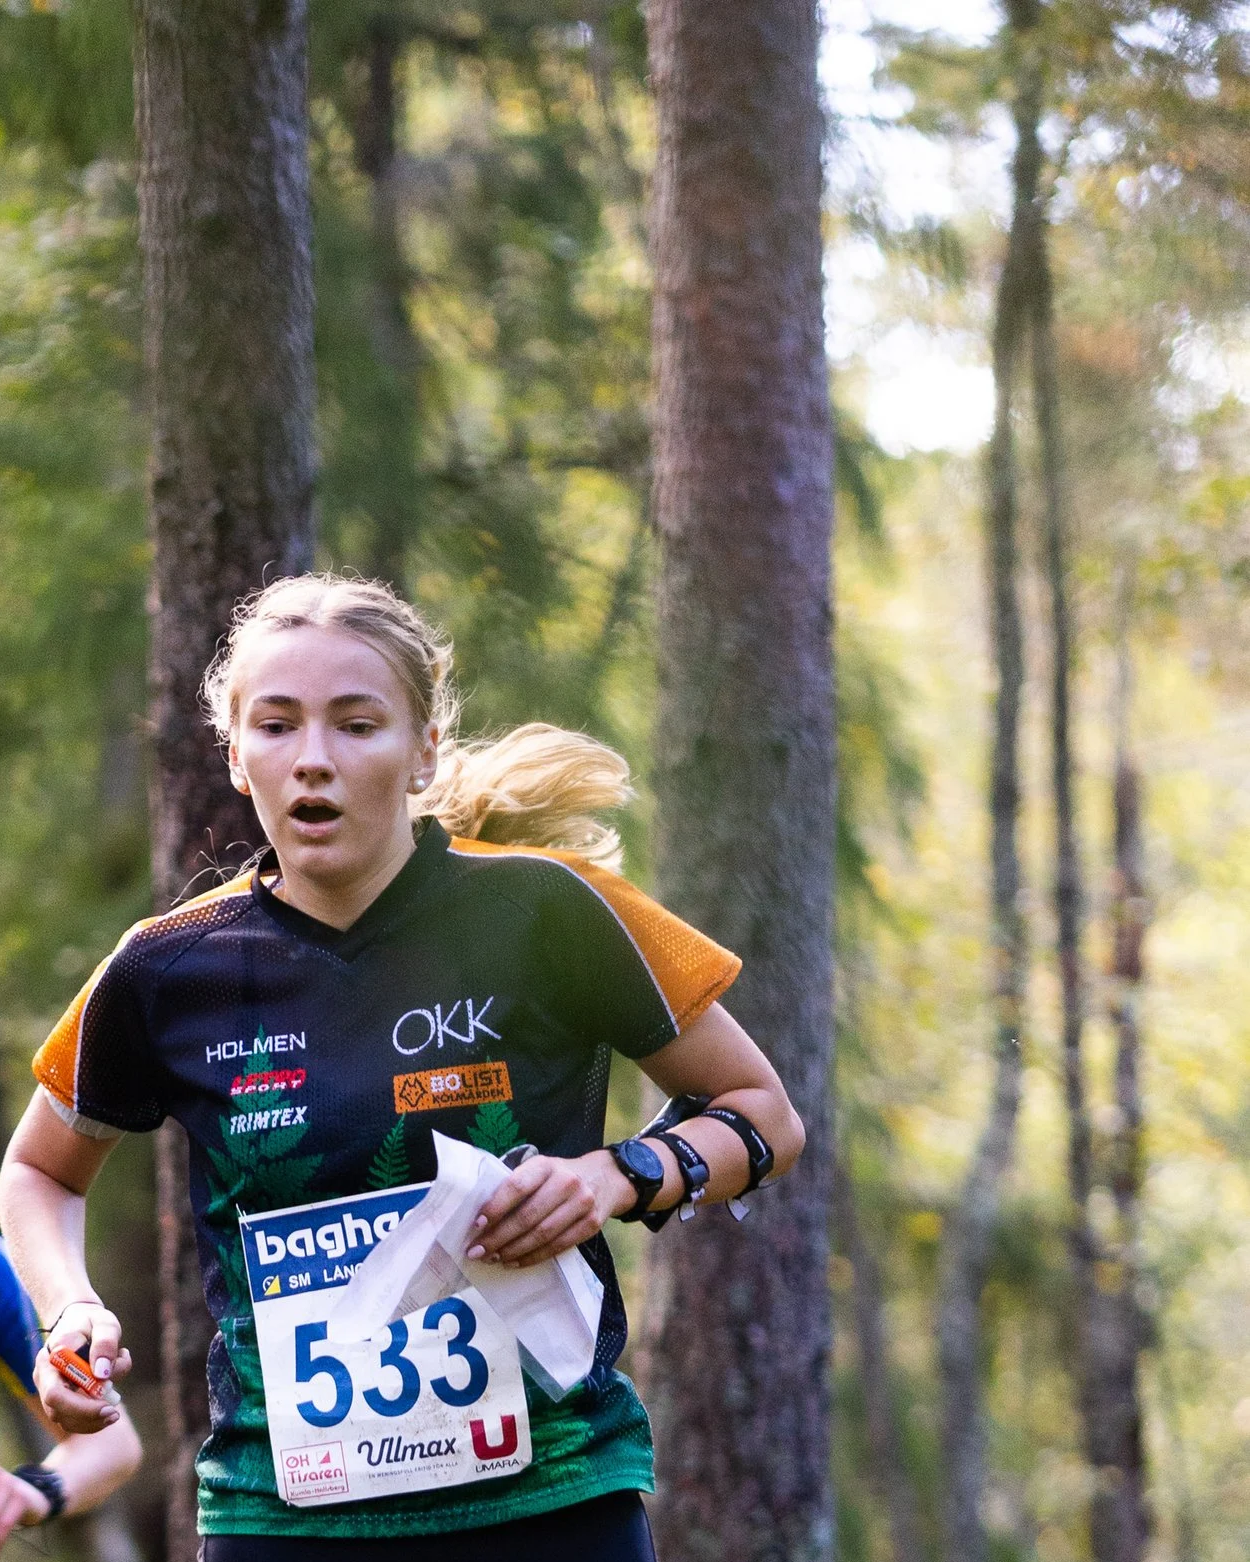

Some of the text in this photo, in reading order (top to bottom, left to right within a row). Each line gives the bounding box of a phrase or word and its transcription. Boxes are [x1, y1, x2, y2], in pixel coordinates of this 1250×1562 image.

[392, 996, 502, 1055] OKK
[206, 1031, 307, 1063] HOLMEN
[230, 1080, 302, 1096] SPORT
[430, 1069, 503, 1093] BOLIST
[230, 1106, 308, 1135] TRIMTEX
[289, 1271, 312, 1289] SM
[295, 1297, 489, 1428] 533
[357, 1436, 456, 1467] Ullmax
[288, 1468, 343, 1484] Tisaren
[475, 1459, 520, 1473] UMARA
